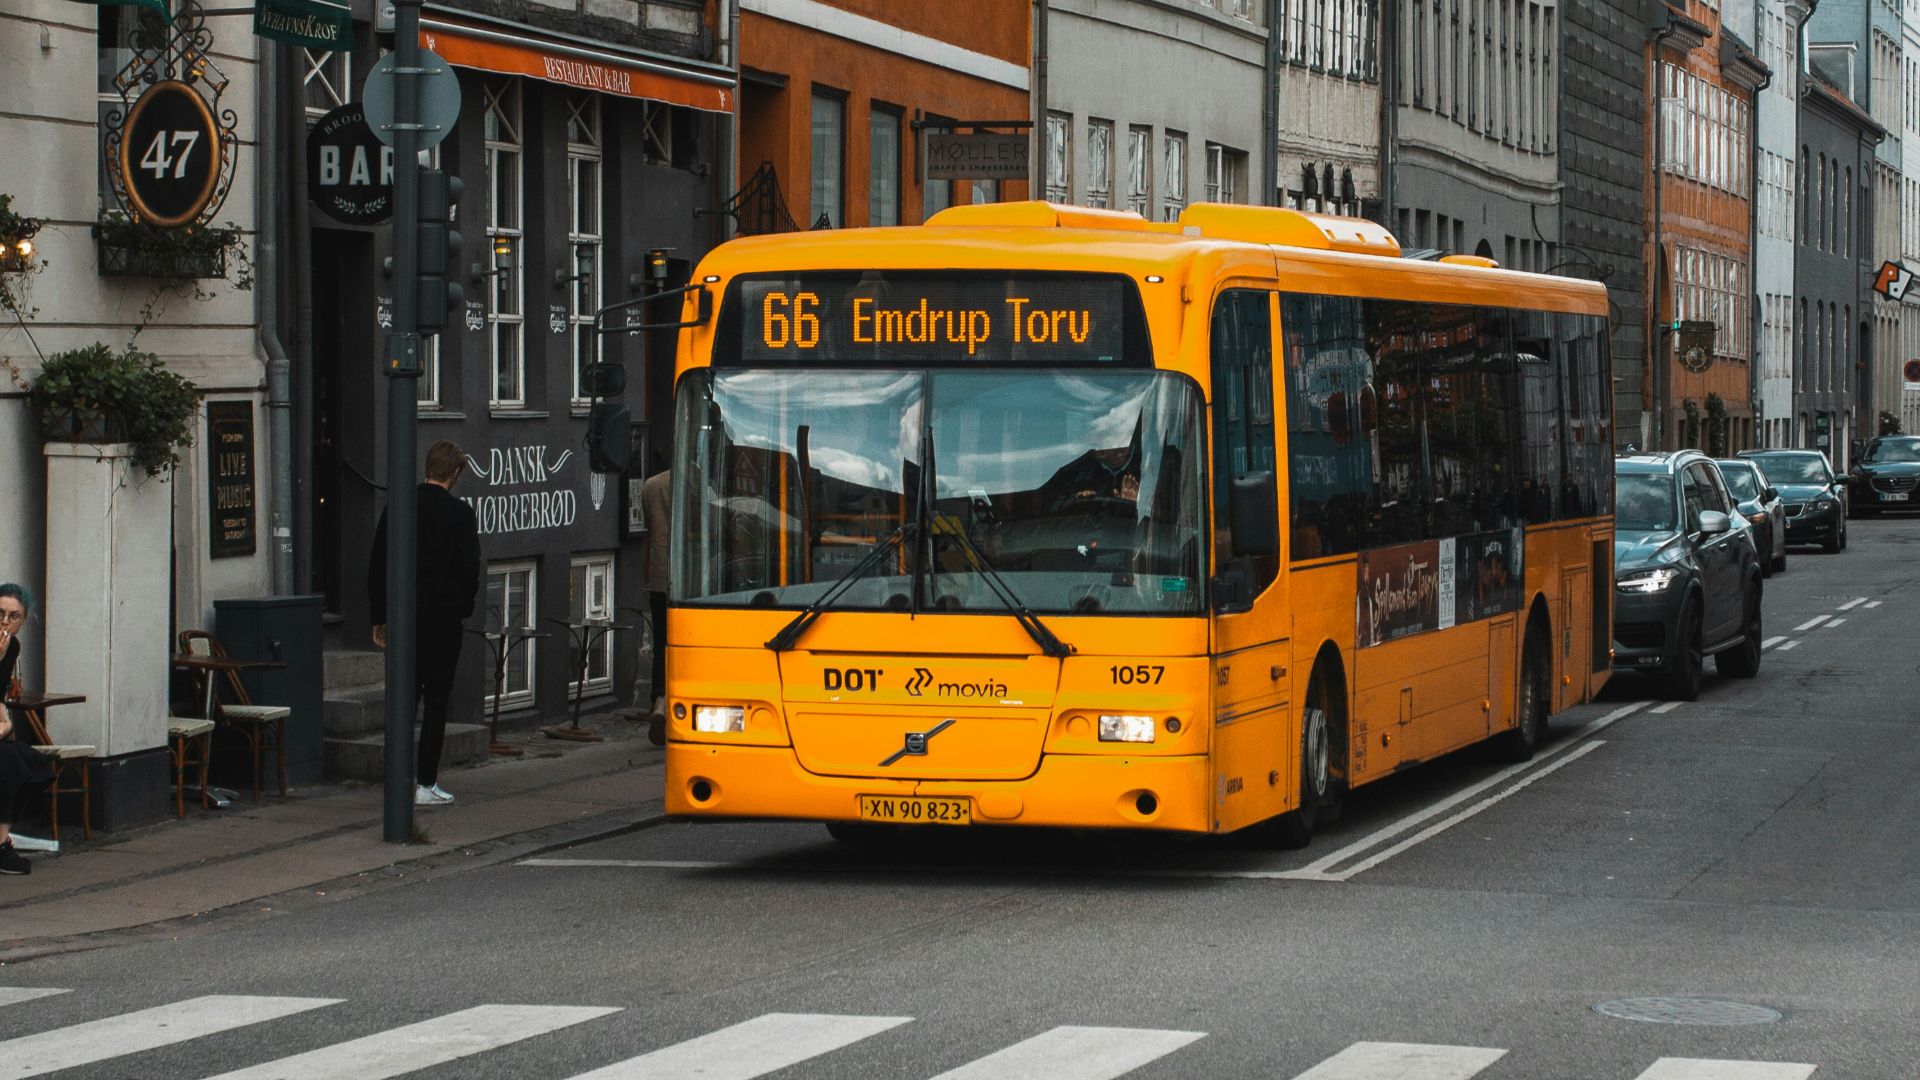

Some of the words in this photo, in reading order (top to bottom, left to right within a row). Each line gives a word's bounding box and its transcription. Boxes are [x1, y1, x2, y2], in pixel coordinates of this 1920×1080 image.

[543, 56, 603, 88] RESTAURANT
[604, 68, 612, 90] &
[612, 70, 631, 93] BAR
[140, 130, 199, 179] 47
[929, 143, 1026, 160] MØLLER
[763, 292, 819, 348] 66
[854, 298, 990, 355] Emdrup
[1005, 298, 1089, 343] Torv
[219, 452, 247, 477] LIVE
[489, 445, 548, 486] DANSK
[216, 483, 252, 510] MUSIC
[460, 489, 576, 535] MØRREBRØD
[938, 678, 1008, 698] movia
[1110, 665, 1165, 685] 1057
[1216, 666, 1230, 687] 1057
[871, 800, 894, 817] XN
[900, 801, 921, 819] 90
[927, 802, 961, 820] 823
